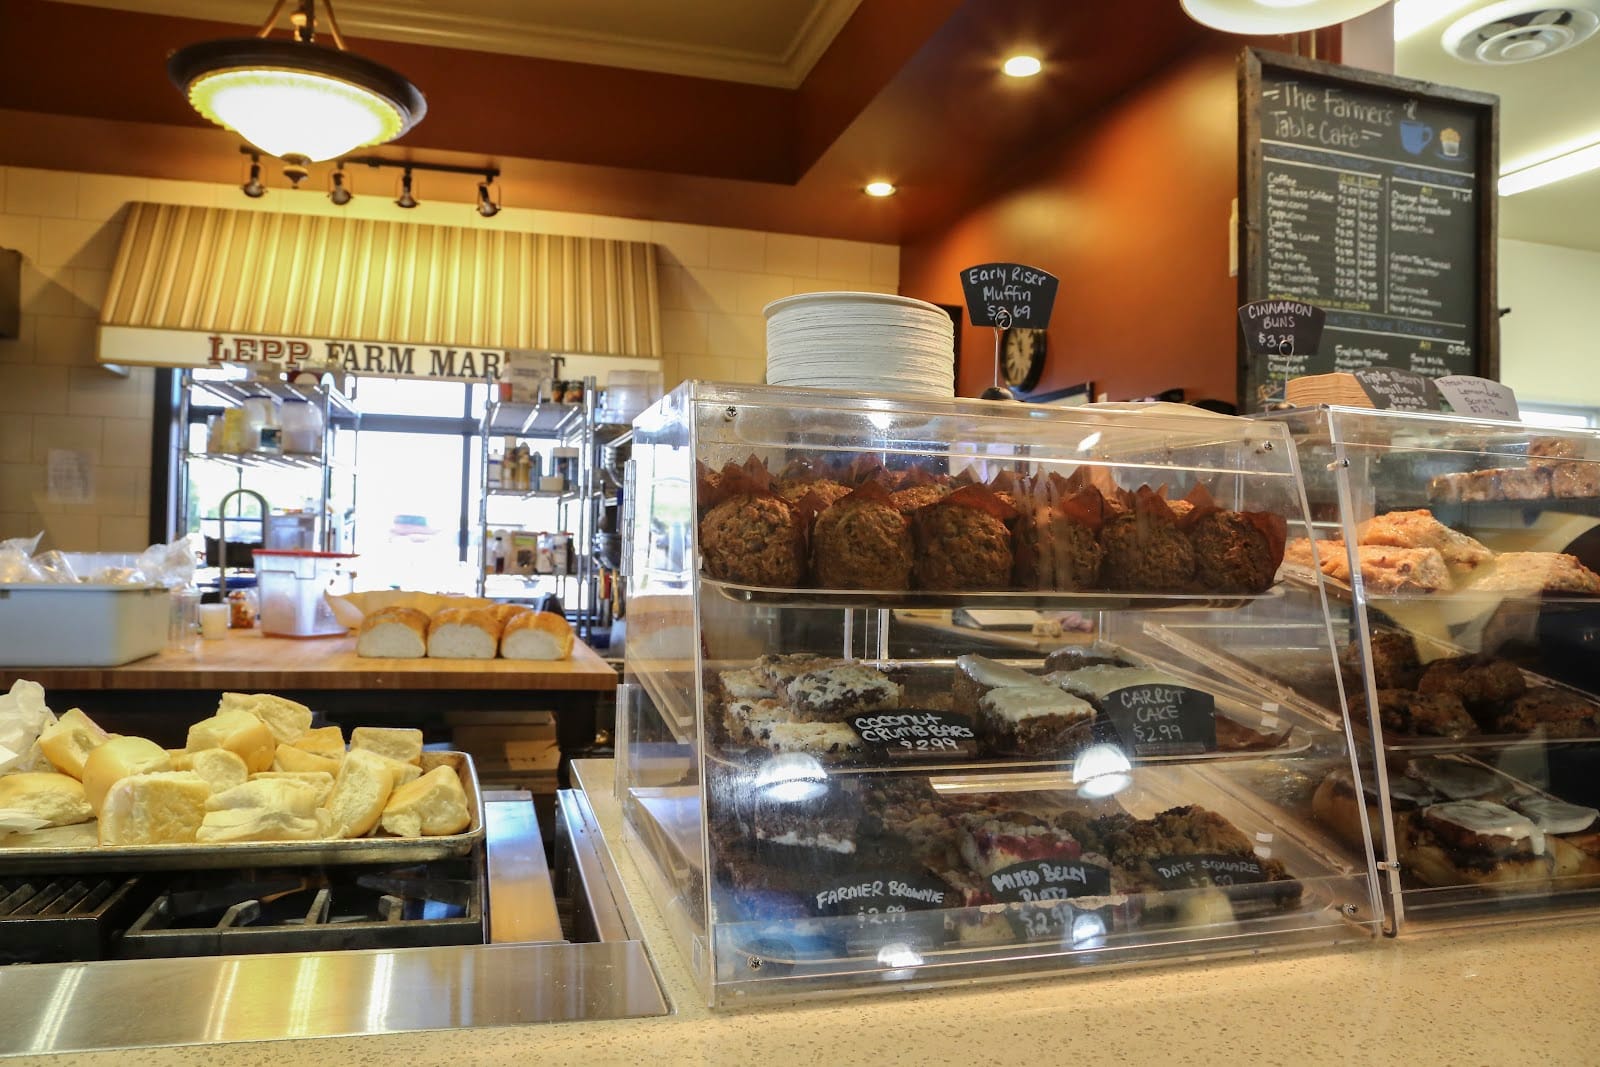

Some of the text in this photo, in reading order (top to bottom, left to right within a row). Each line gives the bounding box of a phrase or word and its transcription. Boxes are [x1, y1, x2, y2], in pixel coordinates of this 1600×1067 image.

[1275, 81, 1317, 112] The
[1268, 110, 1317, 139] Table
[1267, 171, 1297, 187] Coffee
[969, 266, 1047, 286] Early Riser
[982, 285, 1032, 302] Muffin
[1248, 302, 1313, 319] CINNAMON
[1263, 316, 1296, 330] BUNS
[207, 335, 566, 380] LEPP FARM MART
[1355, 370, 1391, 387] Triple
[1120, 687, 1186, 708] CARROT
[1136, 705, 1179, 722] CAKE
[861, 724, 929, 741] CRUMB
[1132, 723, 1184, 742] $2.99
[1158, 860, 1261, 879] DATE SQUARE
[991, 869, 1040, 892] MIXED
[816, 880, 945, 909] FARMER BROWNIE
